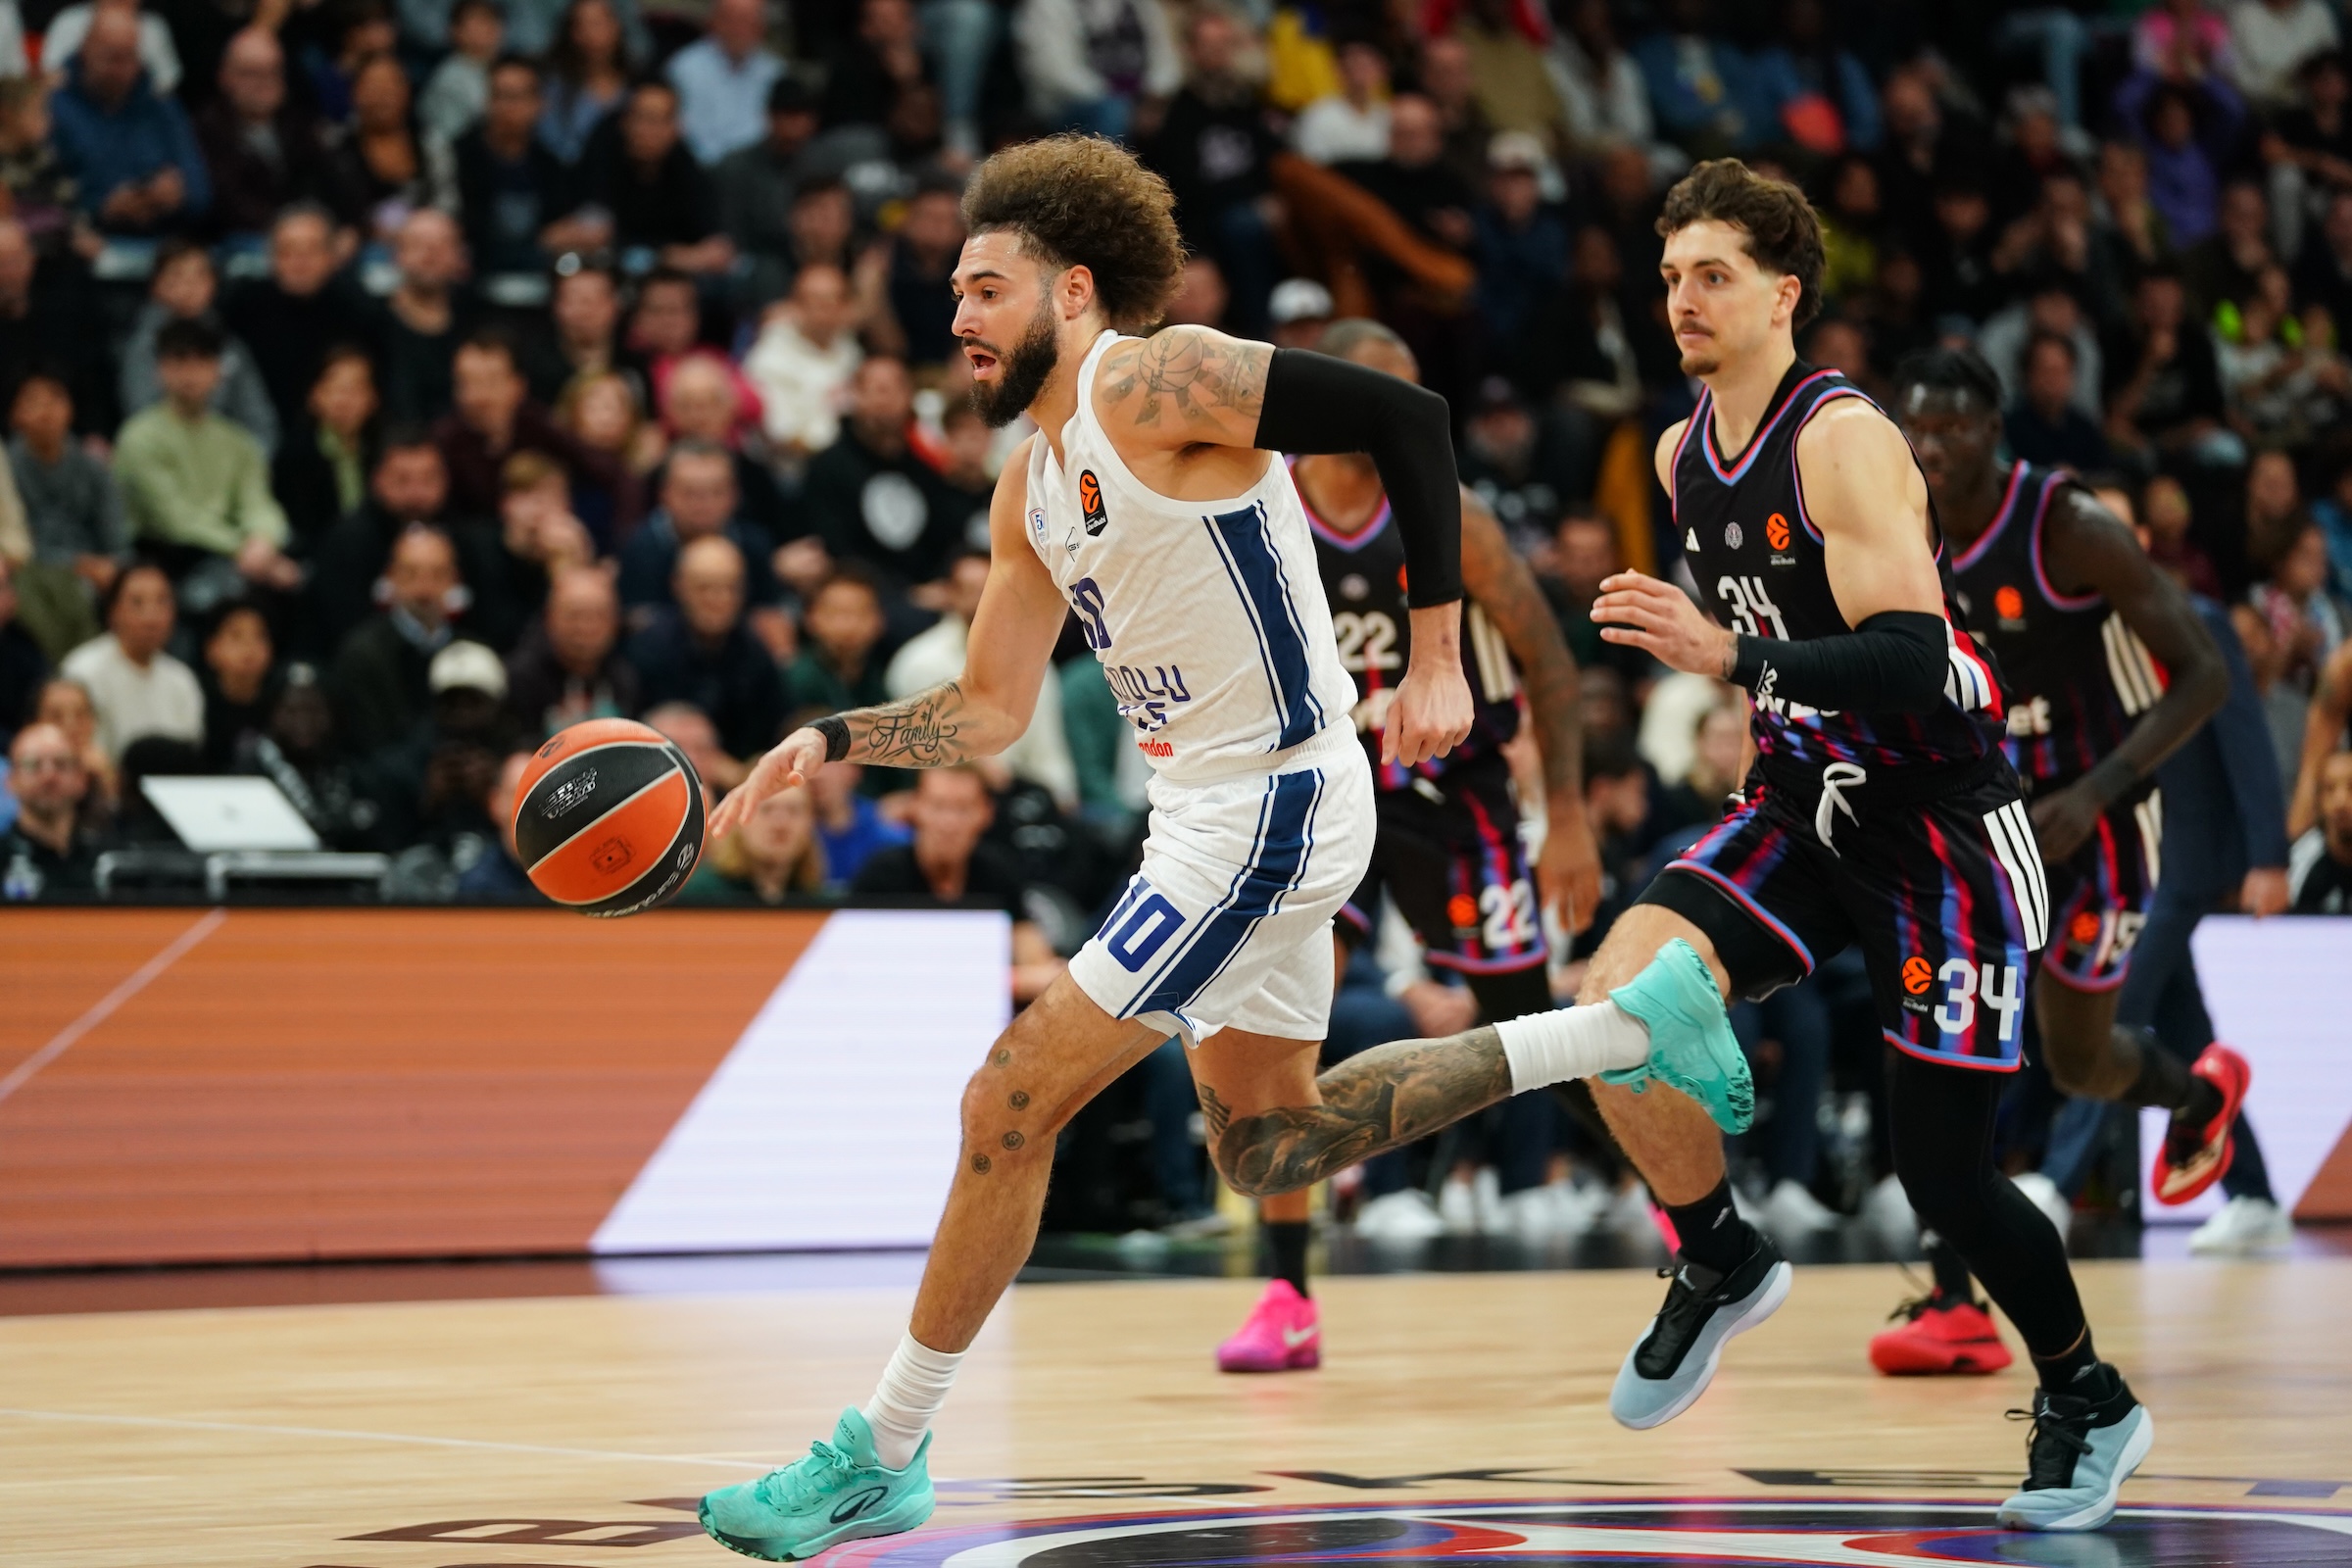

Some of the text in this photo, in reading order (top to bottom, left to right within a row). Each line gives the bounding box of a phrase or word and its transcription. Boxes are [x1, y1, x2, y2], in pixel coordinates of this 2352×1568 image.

[1333, 610, 1402, 672] 22
[1717, 575, 1790, 642] 34
[869, 704, 957, 760] Family
[1097, 875, 1187, 973] 10
[1478, 879, 1539, 949] 22
[1934, 957, 2021, 1041] 34
